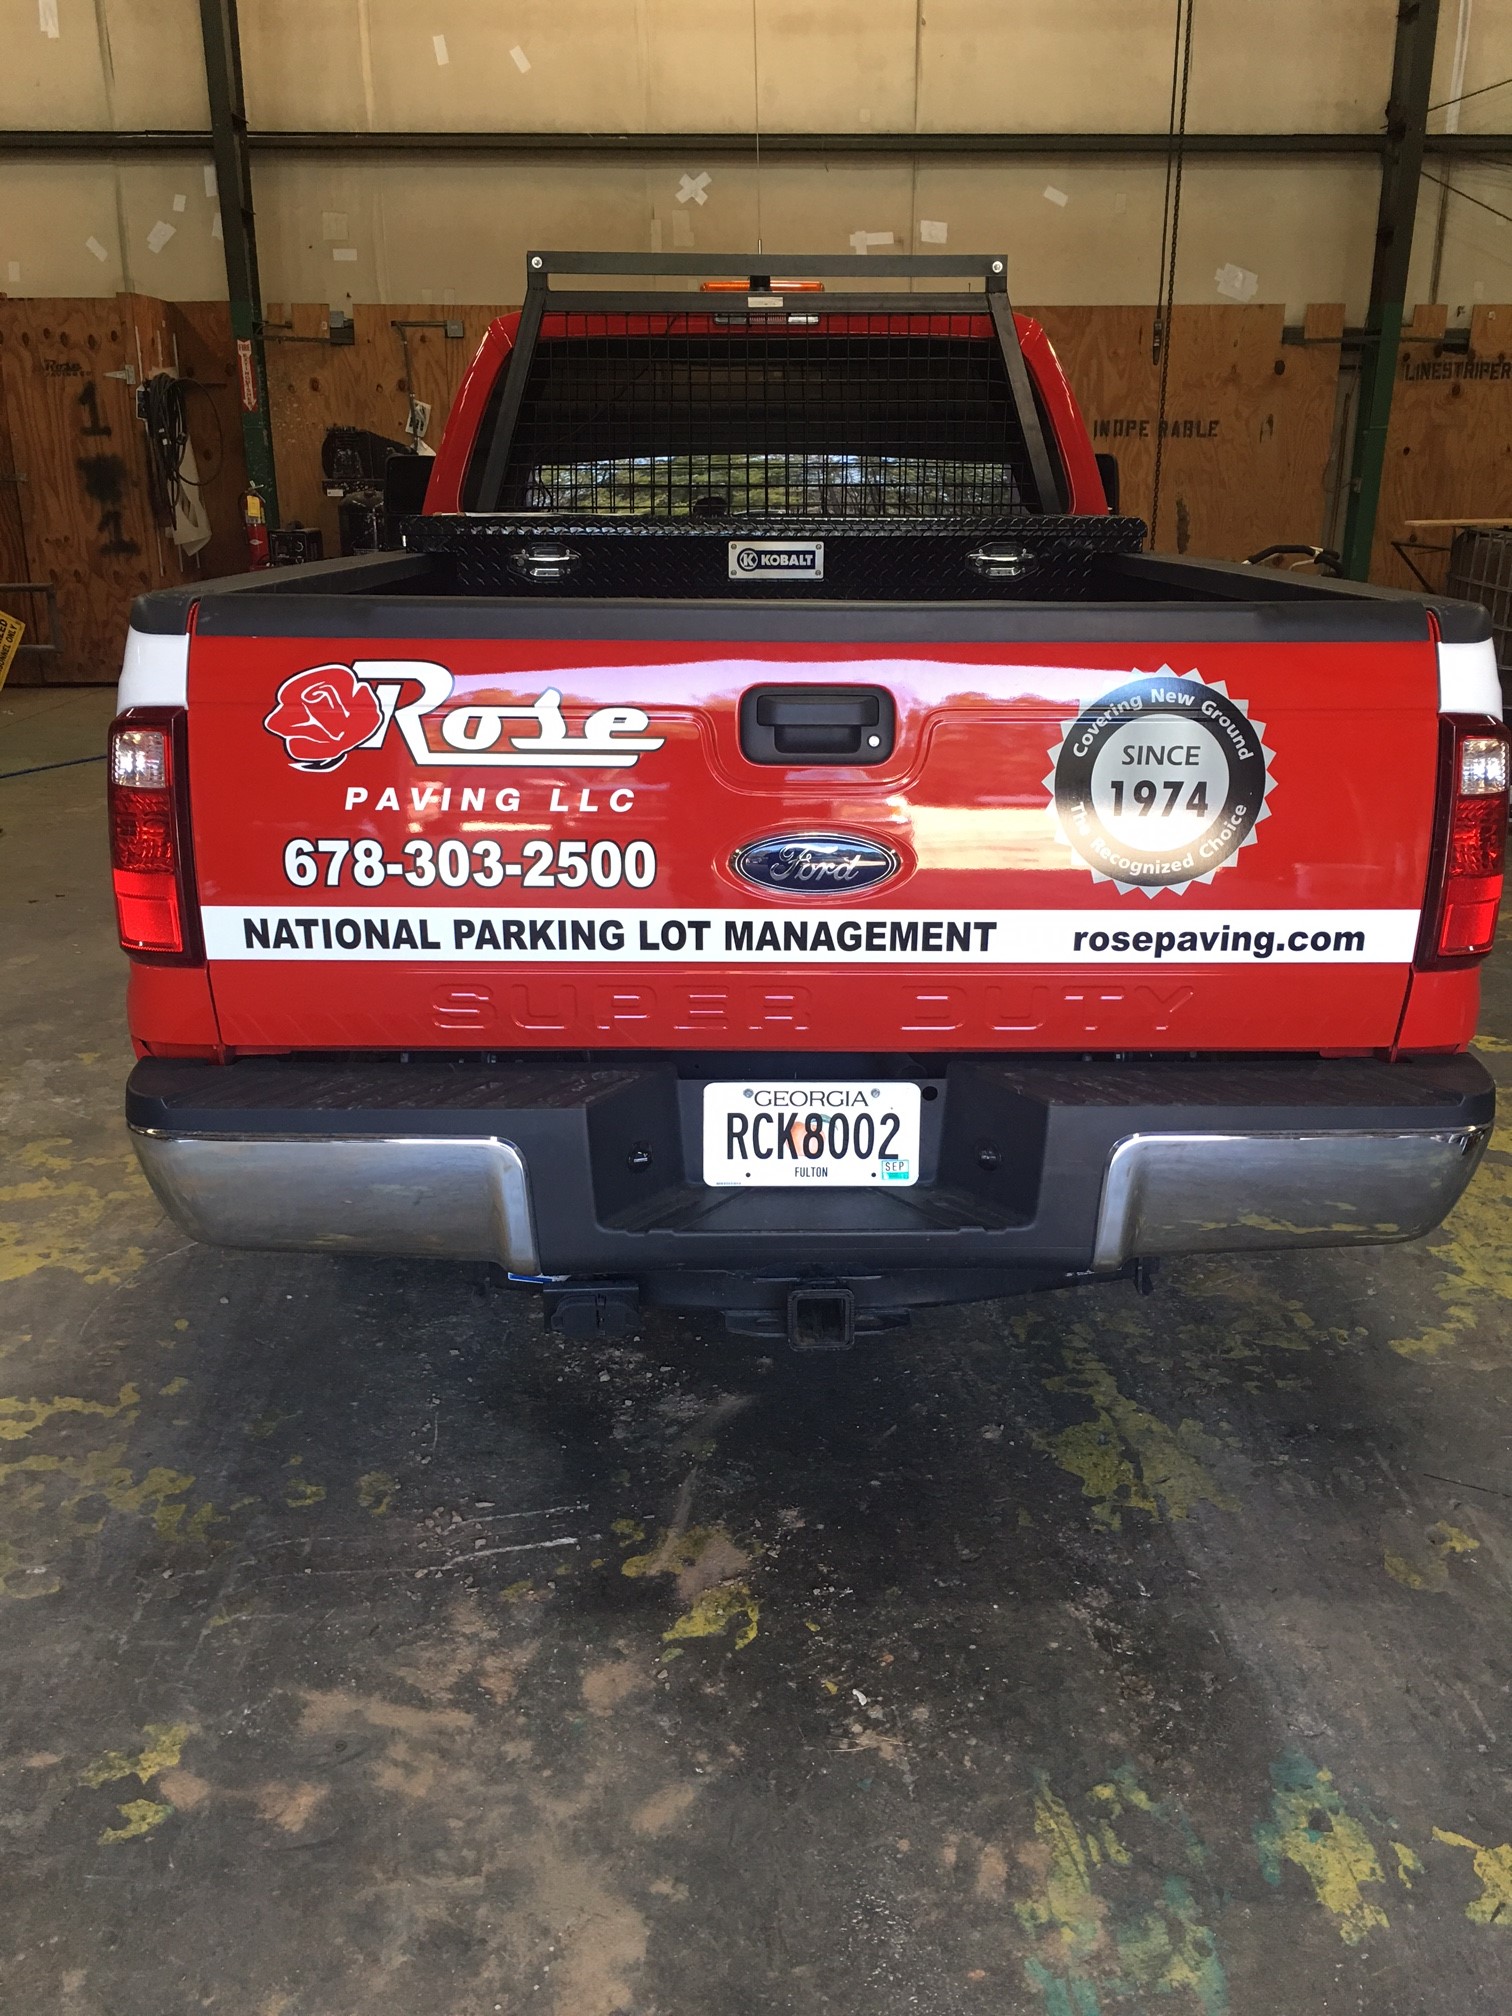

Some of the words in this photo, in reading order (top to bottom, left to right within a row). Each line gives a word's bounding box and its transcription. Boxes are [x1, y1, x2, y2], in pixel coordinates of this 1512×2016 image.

[1403, 361, 1511, 381] LINESTRIPER
[761, 554, 814, 566] KOBALT
[350, 659, 667, 768] Rose
[1073, 694, 1144, 758] Covering
[1150, 688, 1195, 707] New
[1201, 699, 1254, 761] Ground
[1121, 745, 1202, 766] SINCE
[344, 786, 521, 812] PAVING
[549, 787, 636, 812] LLC
[1110, 780, 1209, 818] 1974
[1070, 801, 1091, 837] The
[1090, 839, 1195, 876] Recognized
[1199, 803, 1247, 858] Choice
[283, 837, 658, 889] 678-303-2500
[769, 842, 862, 881] Ford
[243, 918, 441, 950] NATIONAL
[453, 919, 626, 951] PARKING
[639, 920, 711, 951] LOT
[725, 921, 998, 952] MANAGEMENT
[1073, 925, 1366, 959] rosepaving.com
[432, 983, 814, 1030] SUPER
[900, 984, 1195, 1031] DUTY
[753, 1090, 869, 1108] GEORGIA
[727, 1112, 900, 1160] RCK8002
[794, 1166, 828, 1178] FULTON
[885, 1161, 905, 1172] SEP
